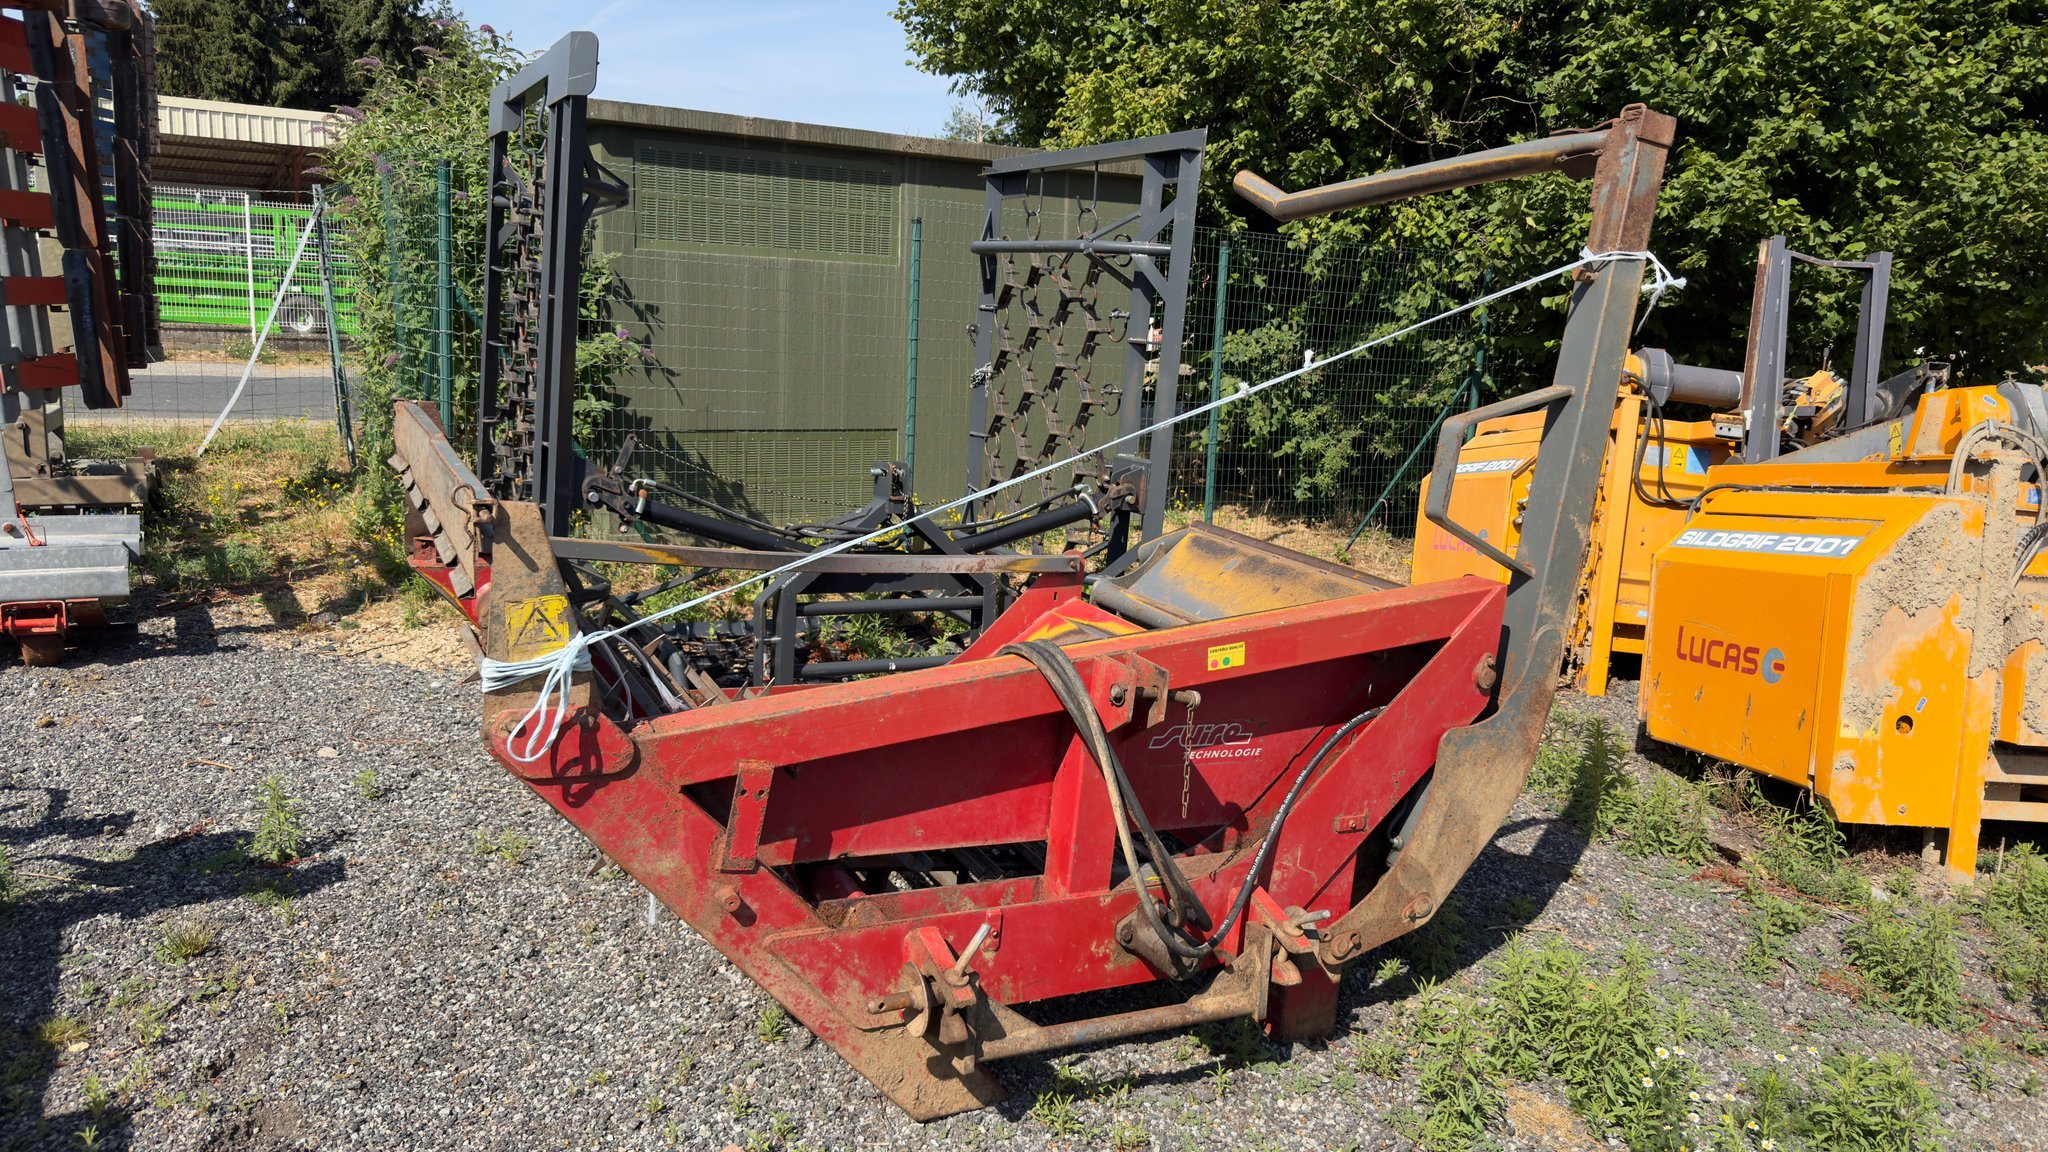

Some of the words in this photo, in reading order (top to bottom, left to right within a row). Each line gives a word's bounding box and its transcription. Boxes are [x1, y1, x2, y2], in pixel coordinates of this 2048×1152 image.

[1482, 458, 1525, 471] 2001
[1676, 530, 1780, 550] SILOGRIF
[1775, 536, 1860, 555] 2001
[1676, 625, 1760, 675] LUCAS
[1183, 748, 1262, 760] TECHNOLOGIE
